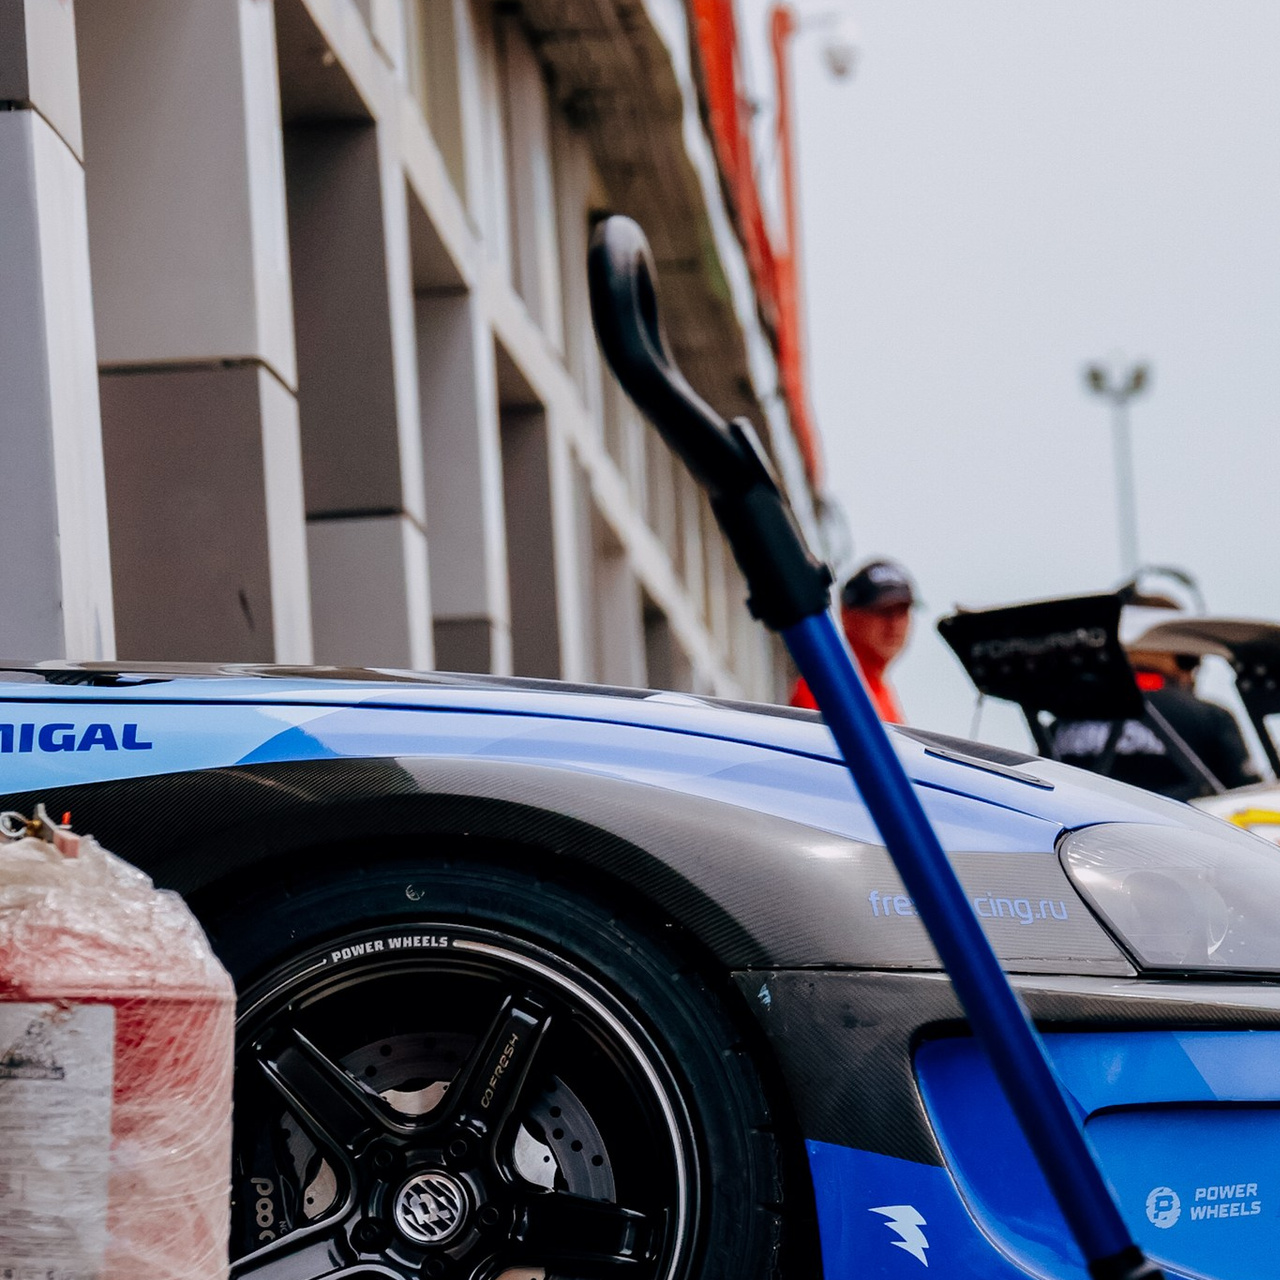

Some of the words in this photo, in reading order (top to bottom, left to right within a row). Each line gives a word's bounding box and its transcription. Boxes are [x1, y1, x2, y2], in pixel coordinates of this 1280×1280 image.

[331, 939, 385, 963] POWER
[387, 935, 448, 949] WHEELS
[1195, 1183, 1258, 1201] POWER
[1190, 1200, 1261, 1220] WHEELS
